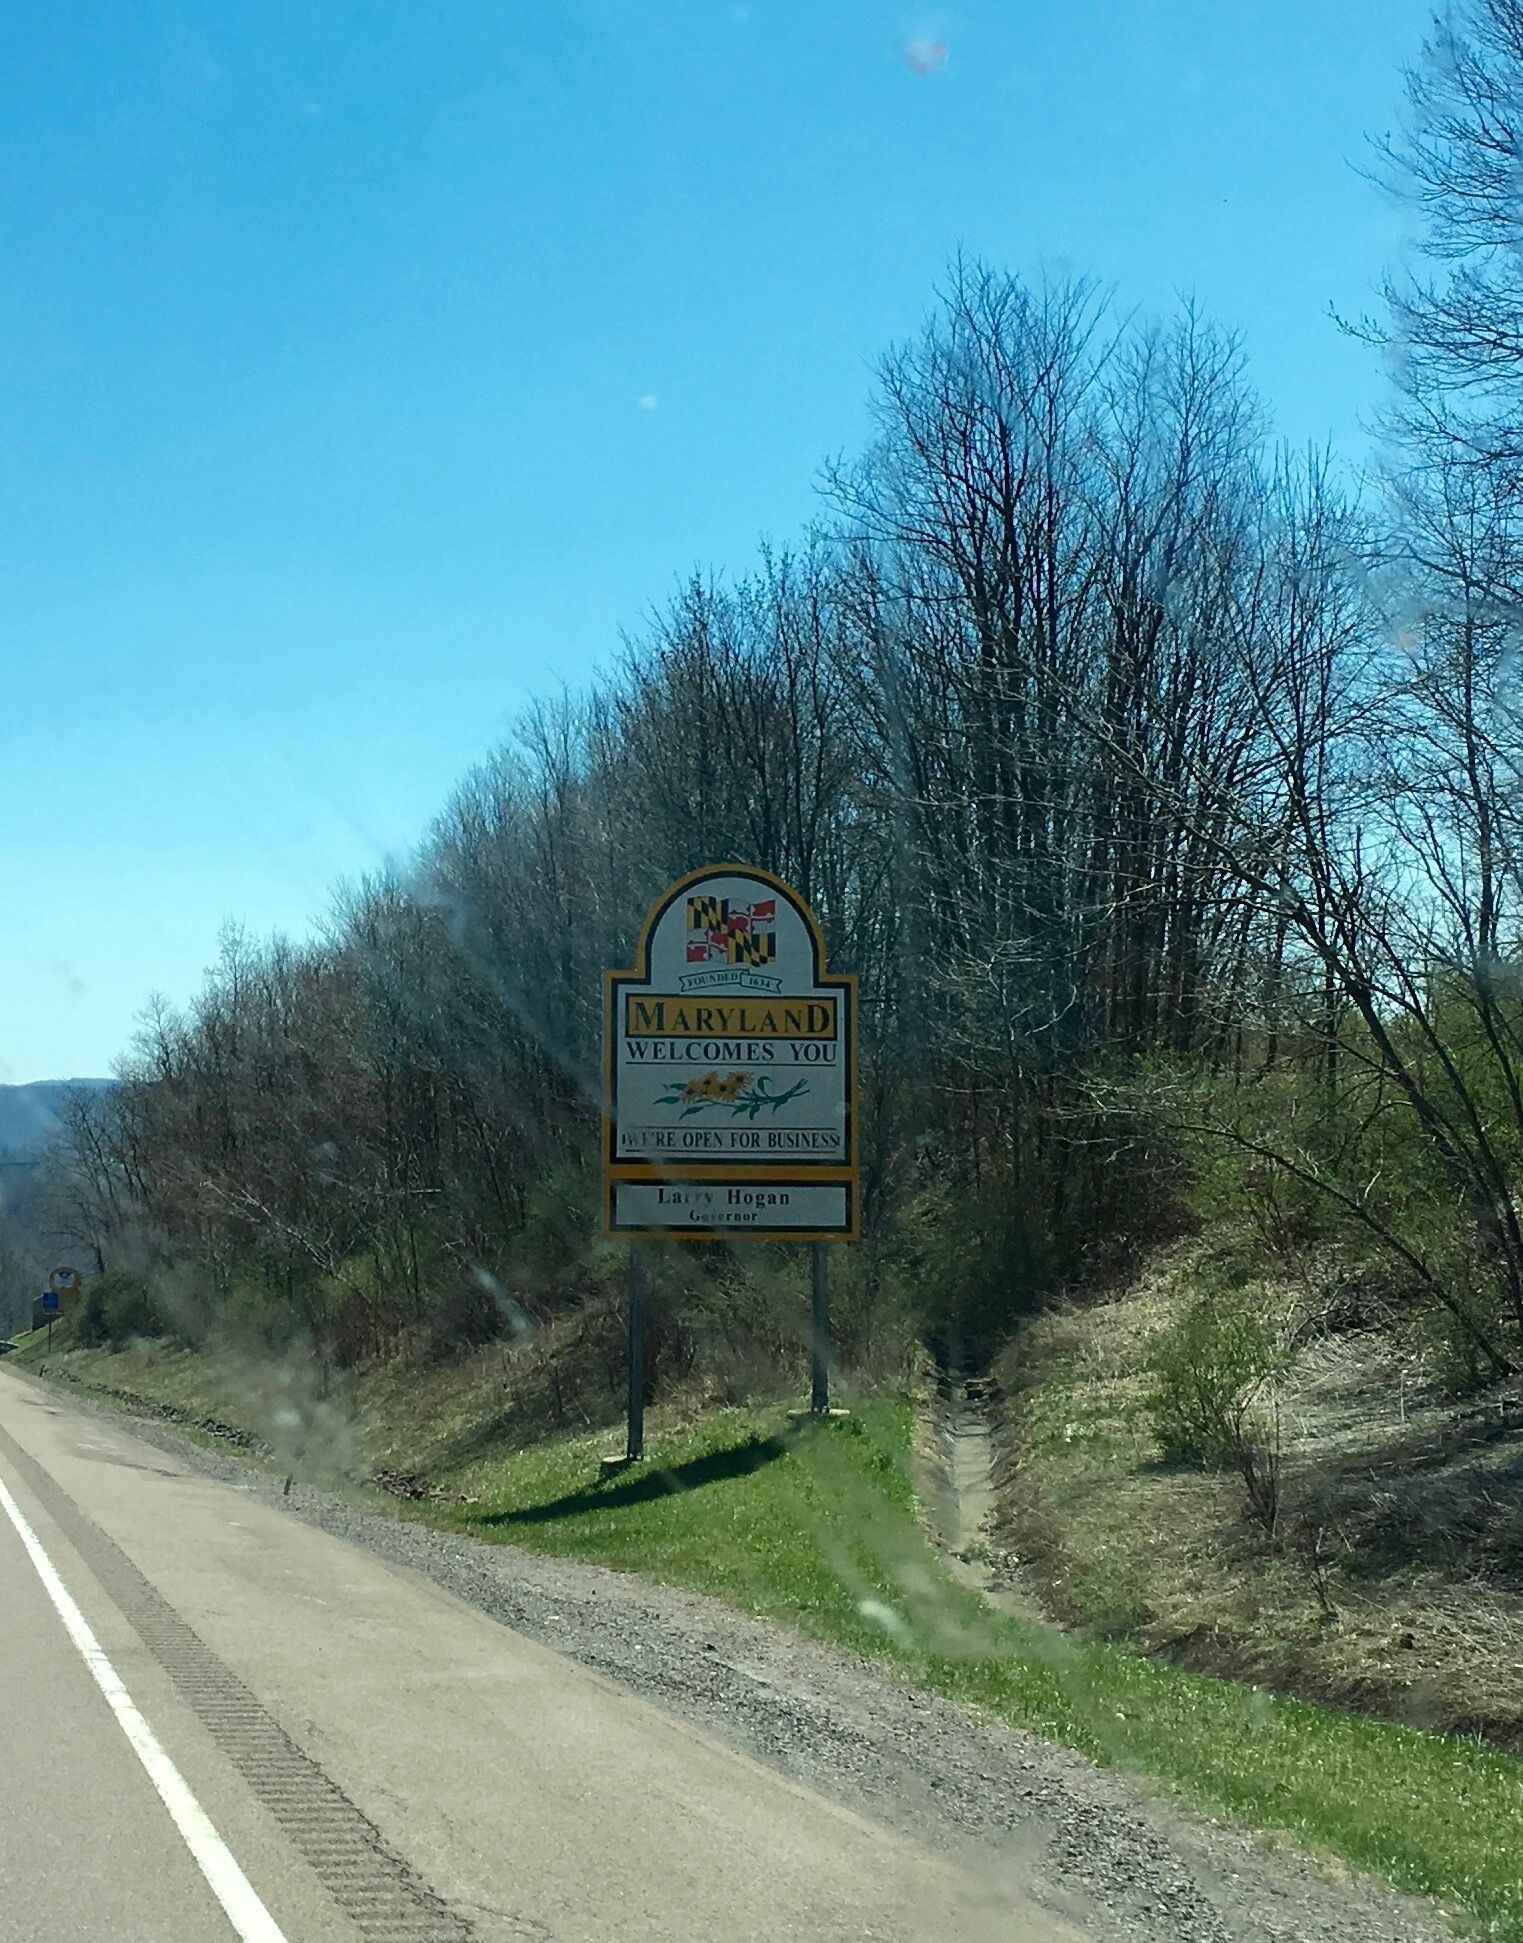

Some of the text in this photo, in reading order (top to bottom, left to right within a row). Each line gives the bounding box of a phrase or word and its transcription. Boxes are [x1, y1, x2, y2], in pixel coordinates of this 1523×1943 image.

[688, 973, 771, 989] FOUNDED 1634
[633, 1002, 830, 1033] MARYLAND
[626, 1041, 837, 1062] WELCOMES YOU
[683, 1131, 723, 1148] OPEN
[731, 1132, 760, 1148] FOR
[768, 1132, 838, 1148] BUSINESS
[728, 1189, 790, 1208] Hogan
